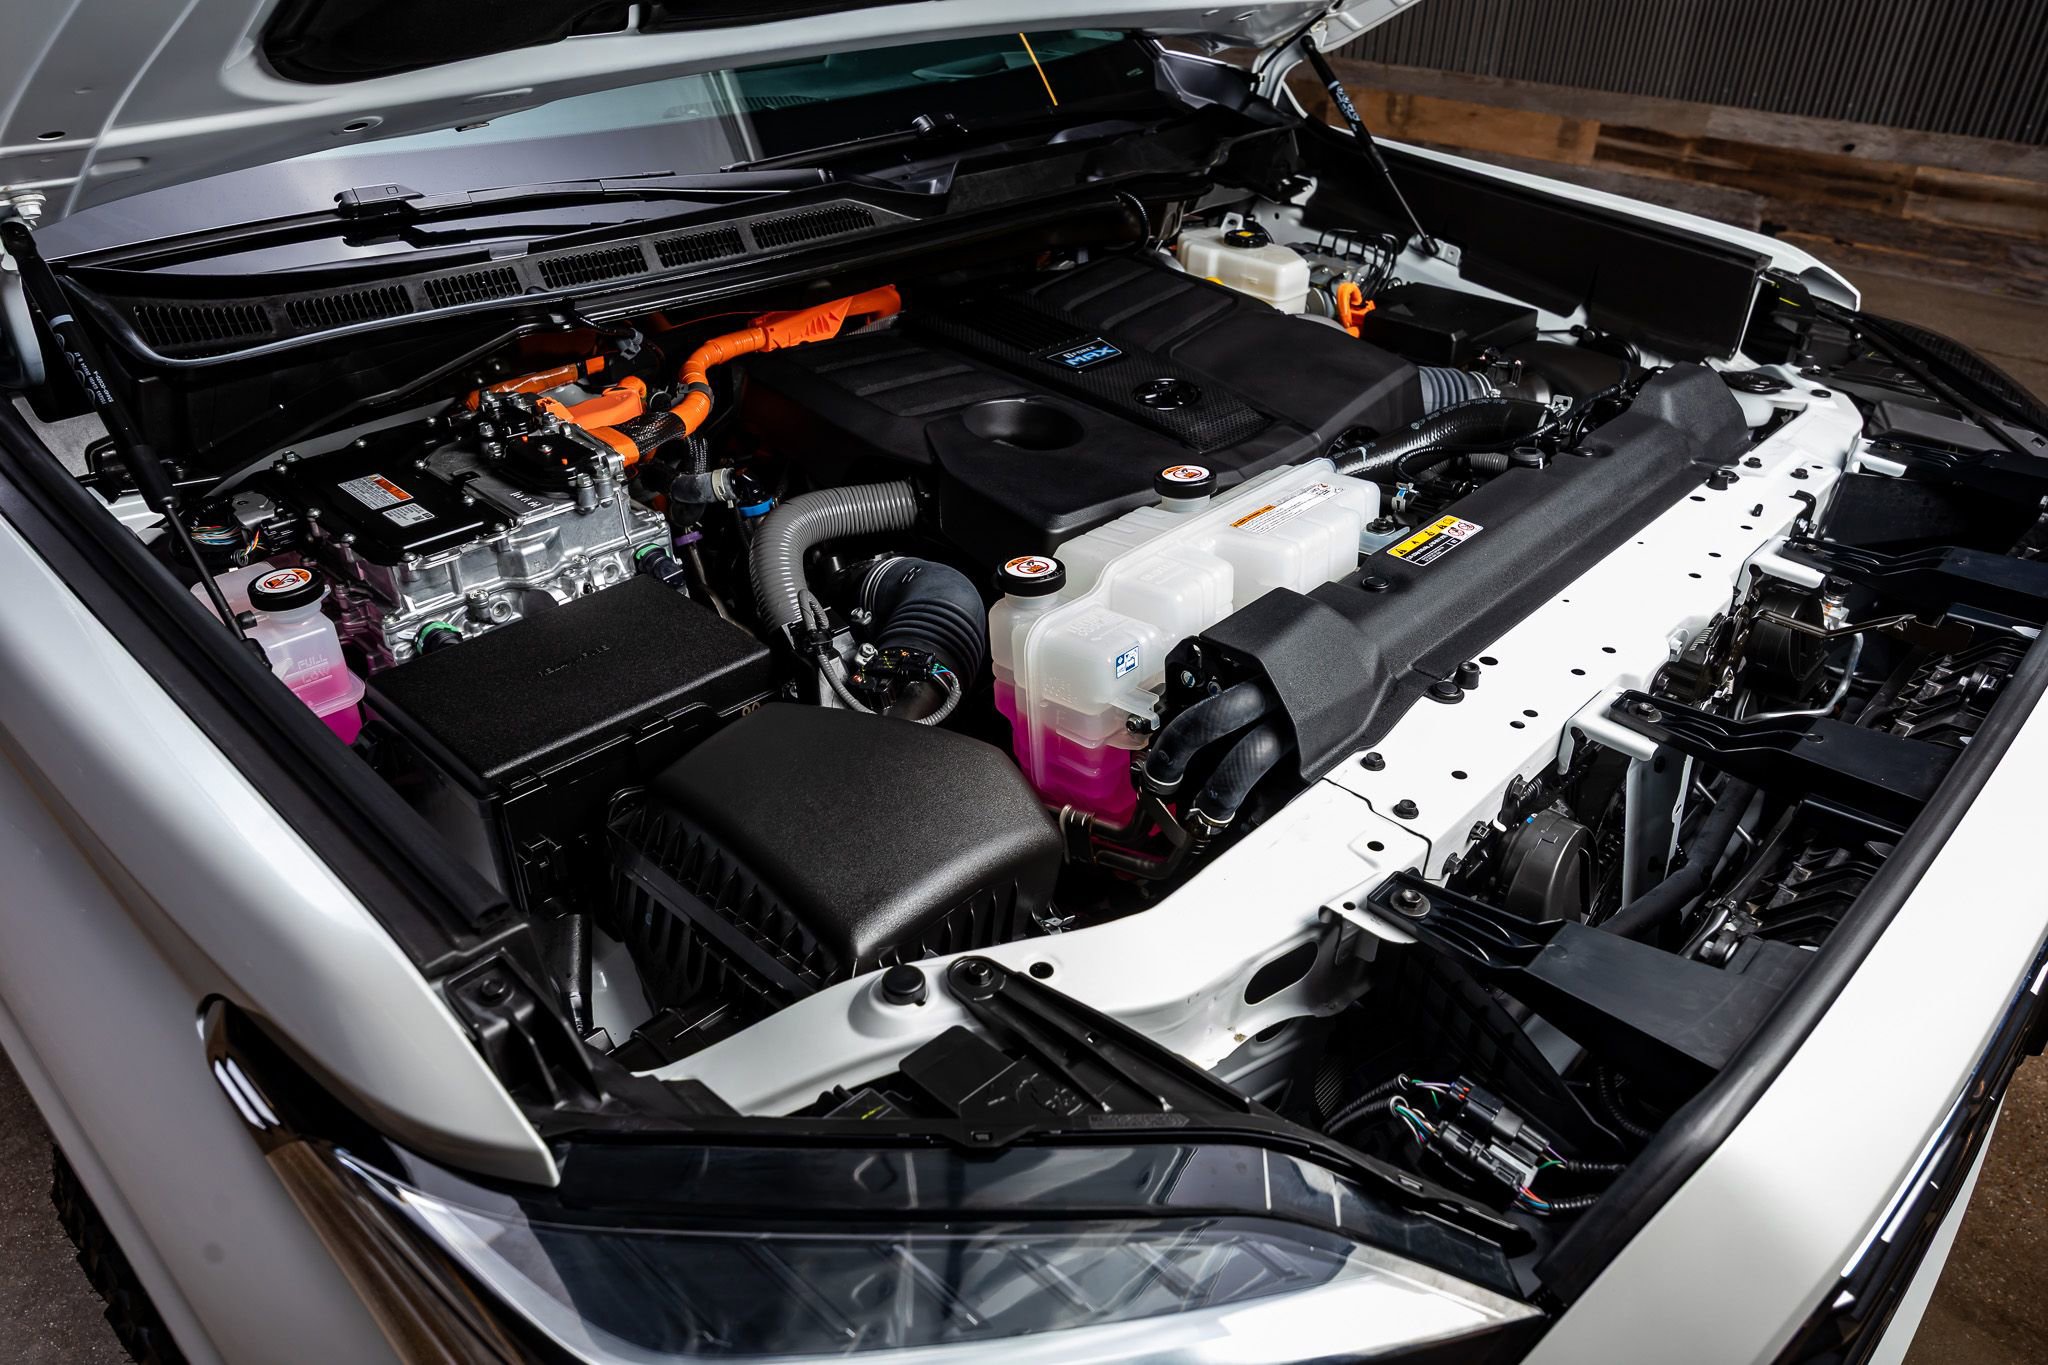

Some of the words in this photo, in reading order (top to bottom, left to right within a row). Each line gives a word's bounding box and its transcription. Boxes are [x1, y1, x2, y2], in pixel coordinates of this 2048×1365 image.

[1065, 346, 1117, 365] MAX
[298, 654, 328, 671] FULL
[303, 667, 329, 683] LOW
